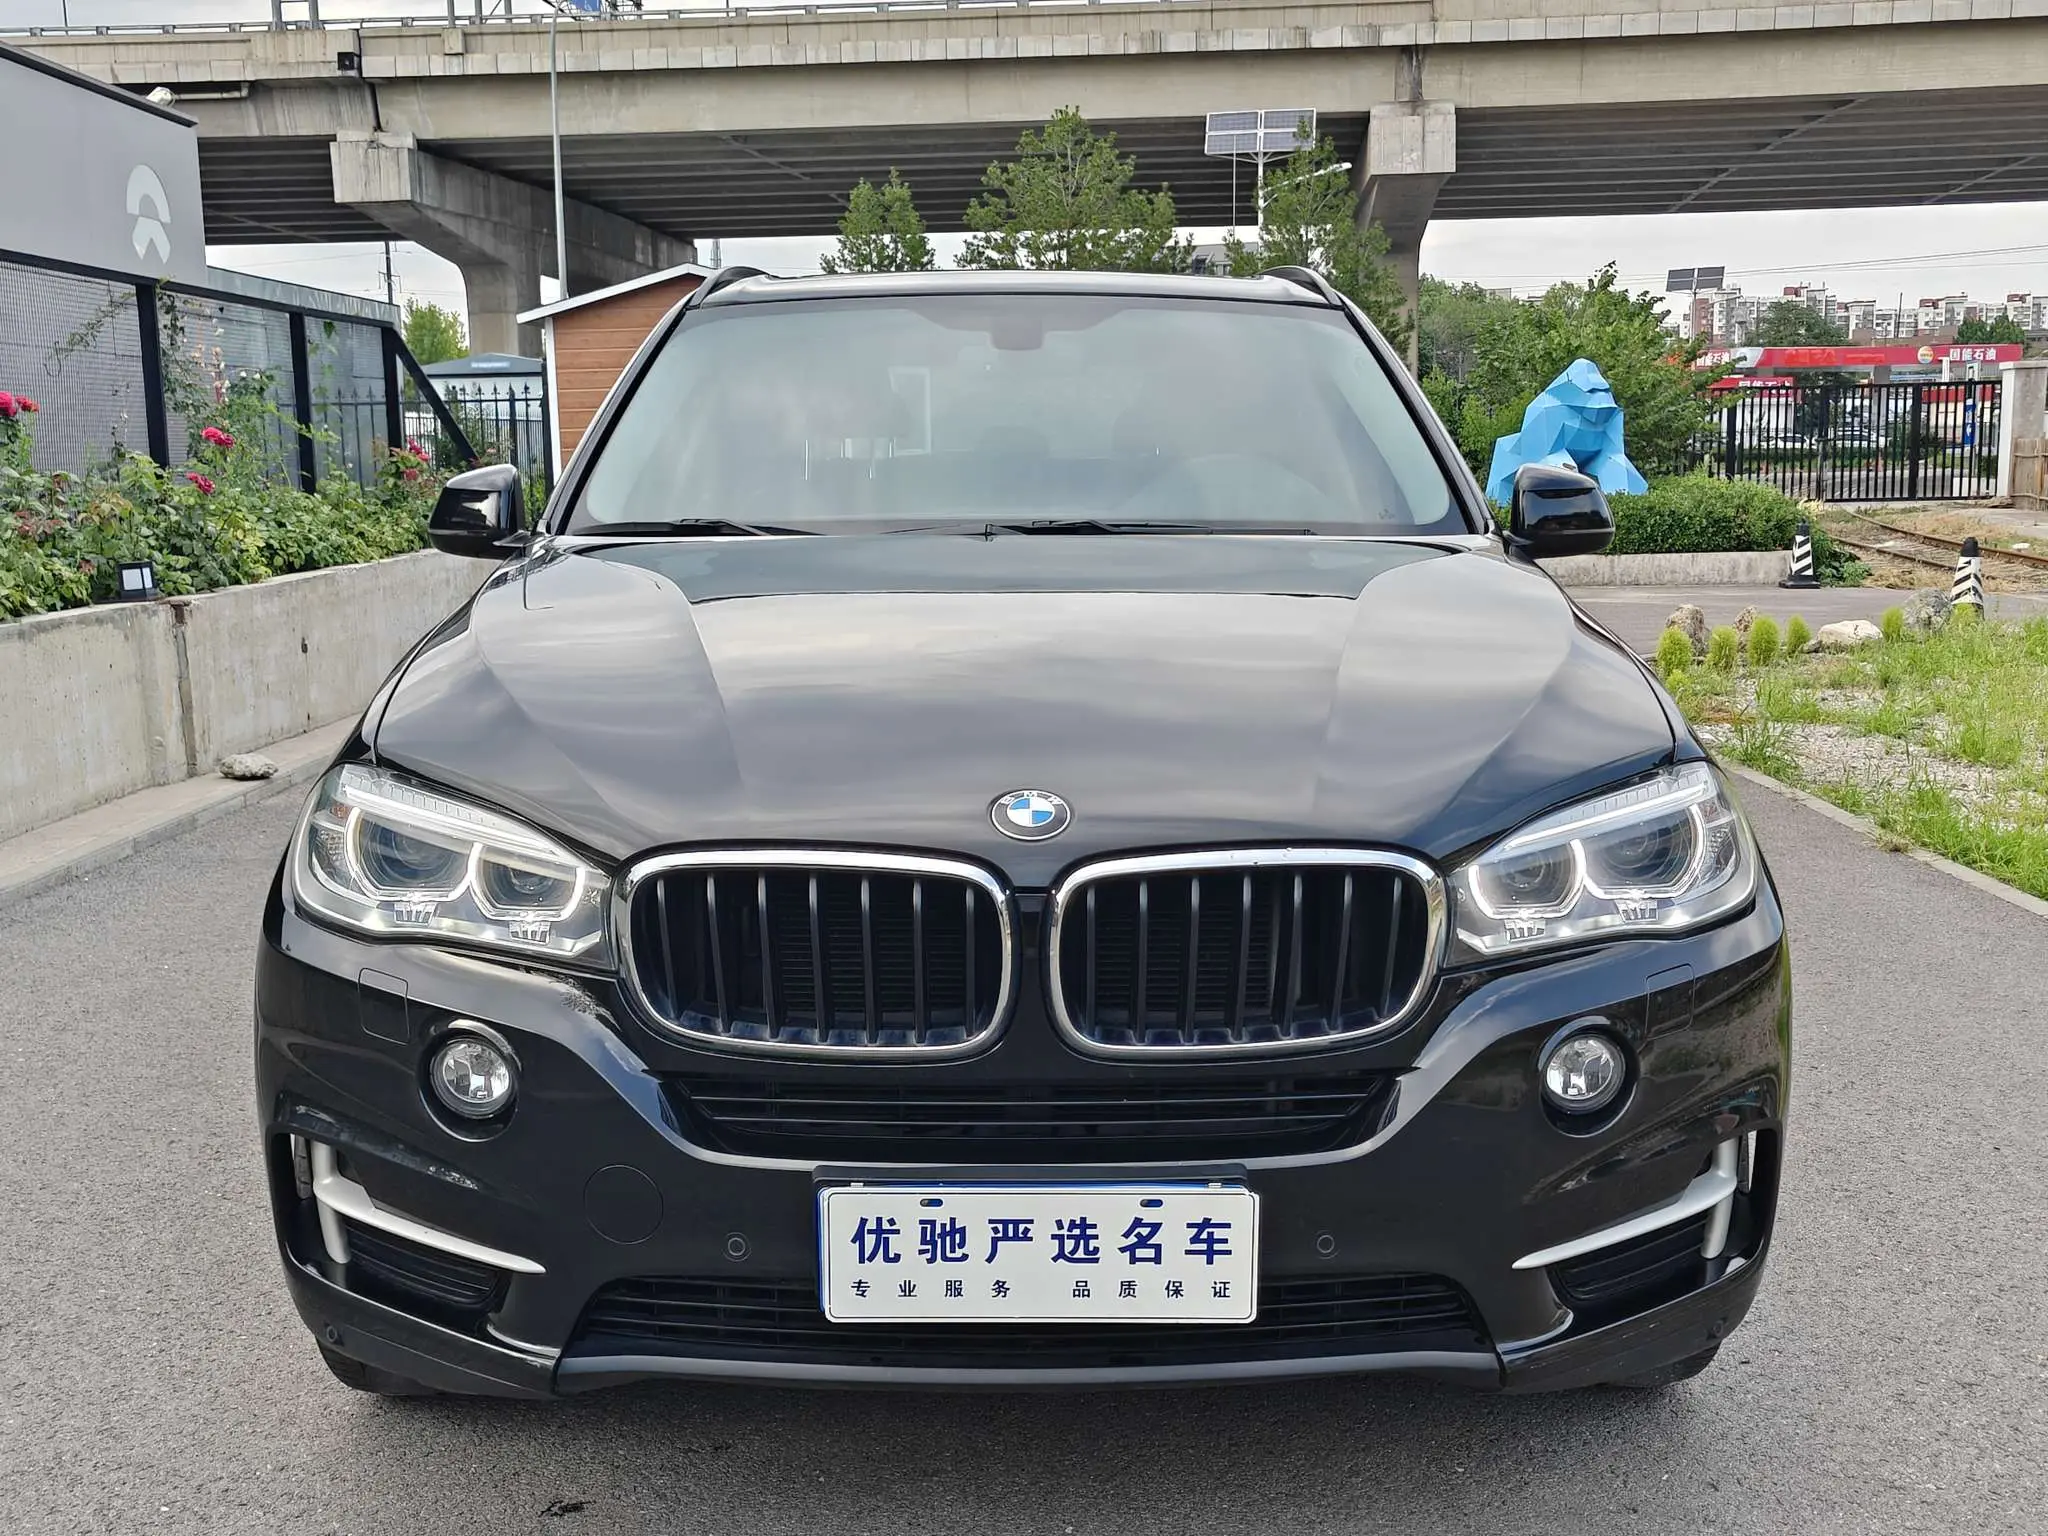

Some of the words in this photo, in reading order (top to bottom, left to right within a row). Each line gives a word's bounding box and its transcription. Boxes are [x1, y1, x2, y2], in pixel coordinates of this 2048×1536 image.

[1949, 348, 1997, 361] 国能石油
[999, 791, 1064, 805] BMW
[850, 1217, 1233, 1265] 优驰严选名车
[851, 1279, 1011, 1298] 专业服务
[1072, 1279, 1231, 1298] 品质保证
